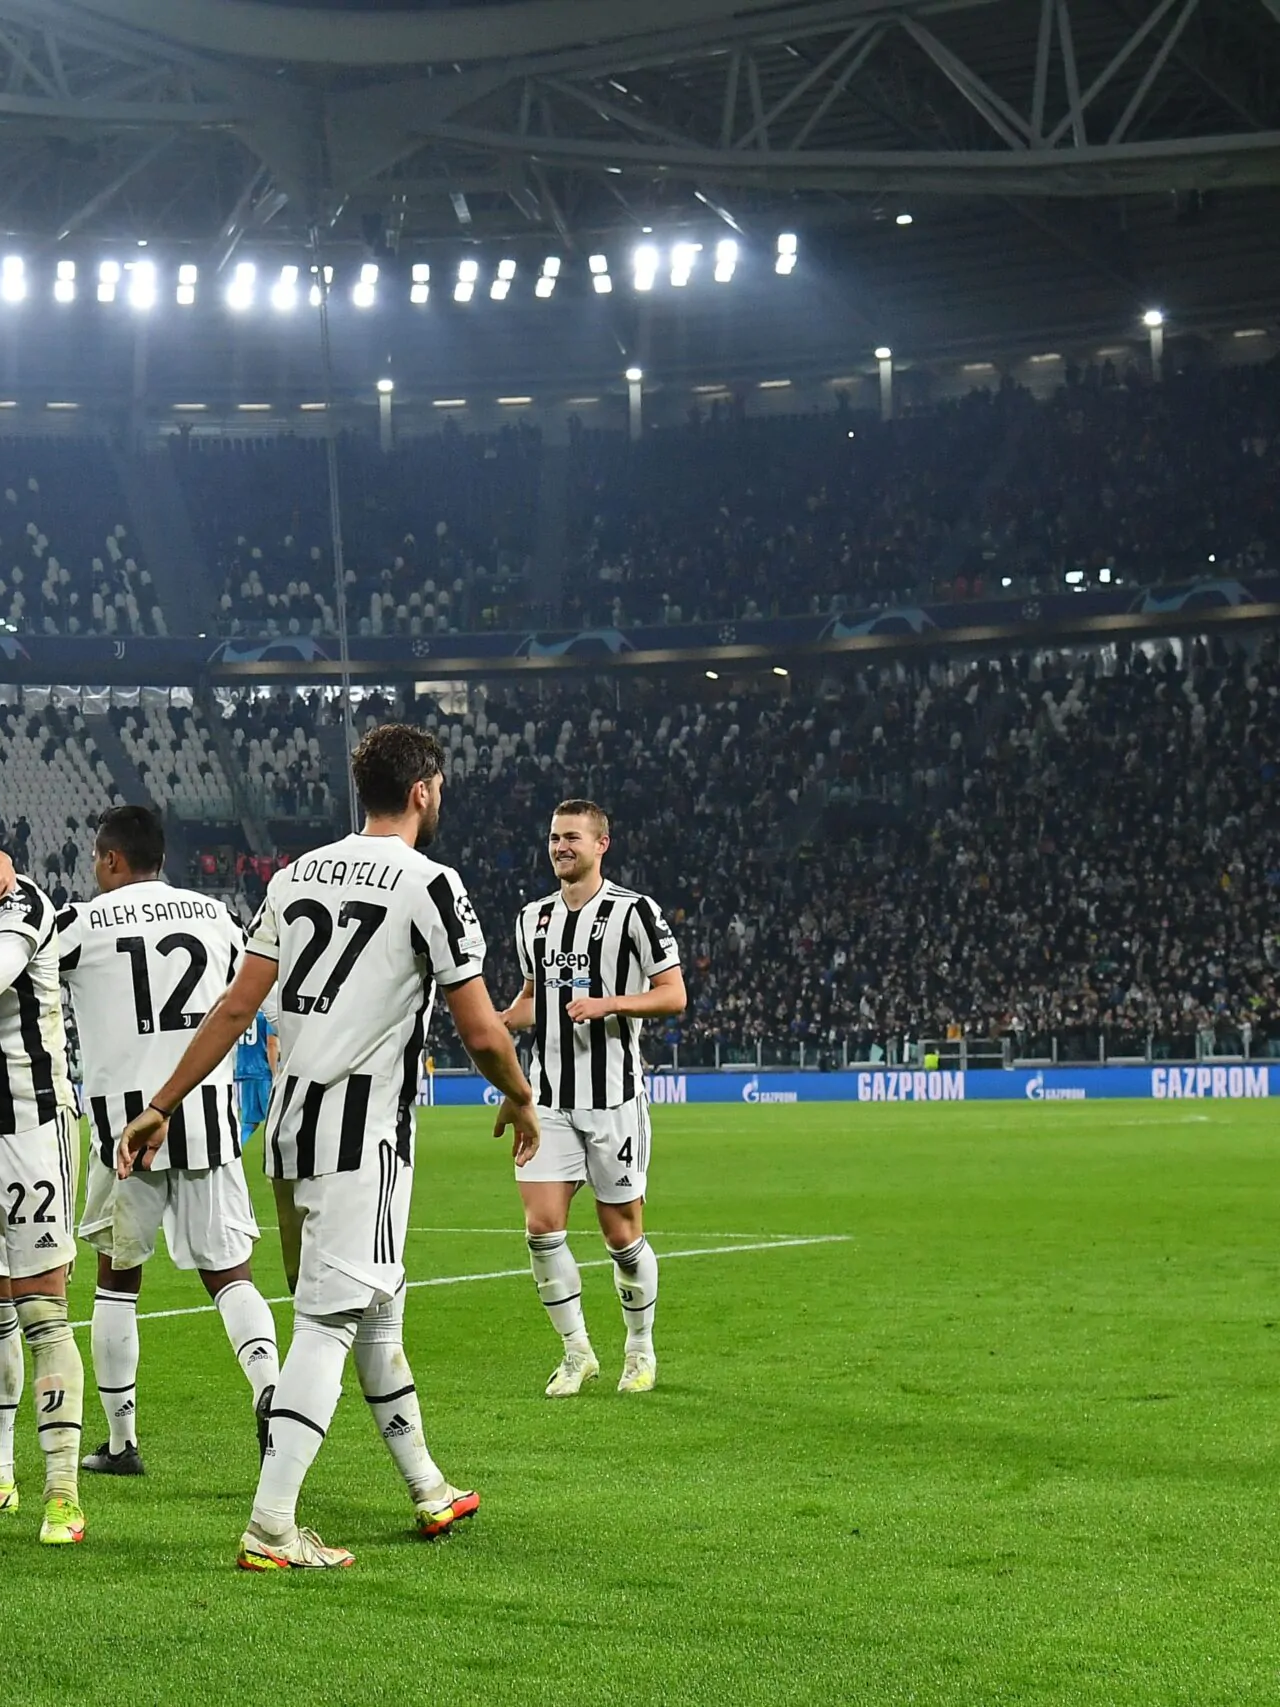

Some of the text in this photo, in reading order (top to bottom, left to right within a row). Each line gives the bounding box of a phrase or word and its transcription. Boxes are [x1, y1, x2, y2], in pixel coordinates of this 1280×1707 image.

[291, 859, 404, 892] LOCATELLI
[89, 901, 218, 930] ALEX SANDRO
[281, 898, 388, 1016] 27
[542, 948, 590, 971] Jeep
[116, 932, 208, 1035] 12
[857, 1071, 965, 1101] GAZPROM
[1151, 1066, 1270, 1099] GAZPROM
[616, 1136, 633, 1168] 4
[6, 1180, 57, 1226] 22
[382, 1423, 416, 1439] adidas
